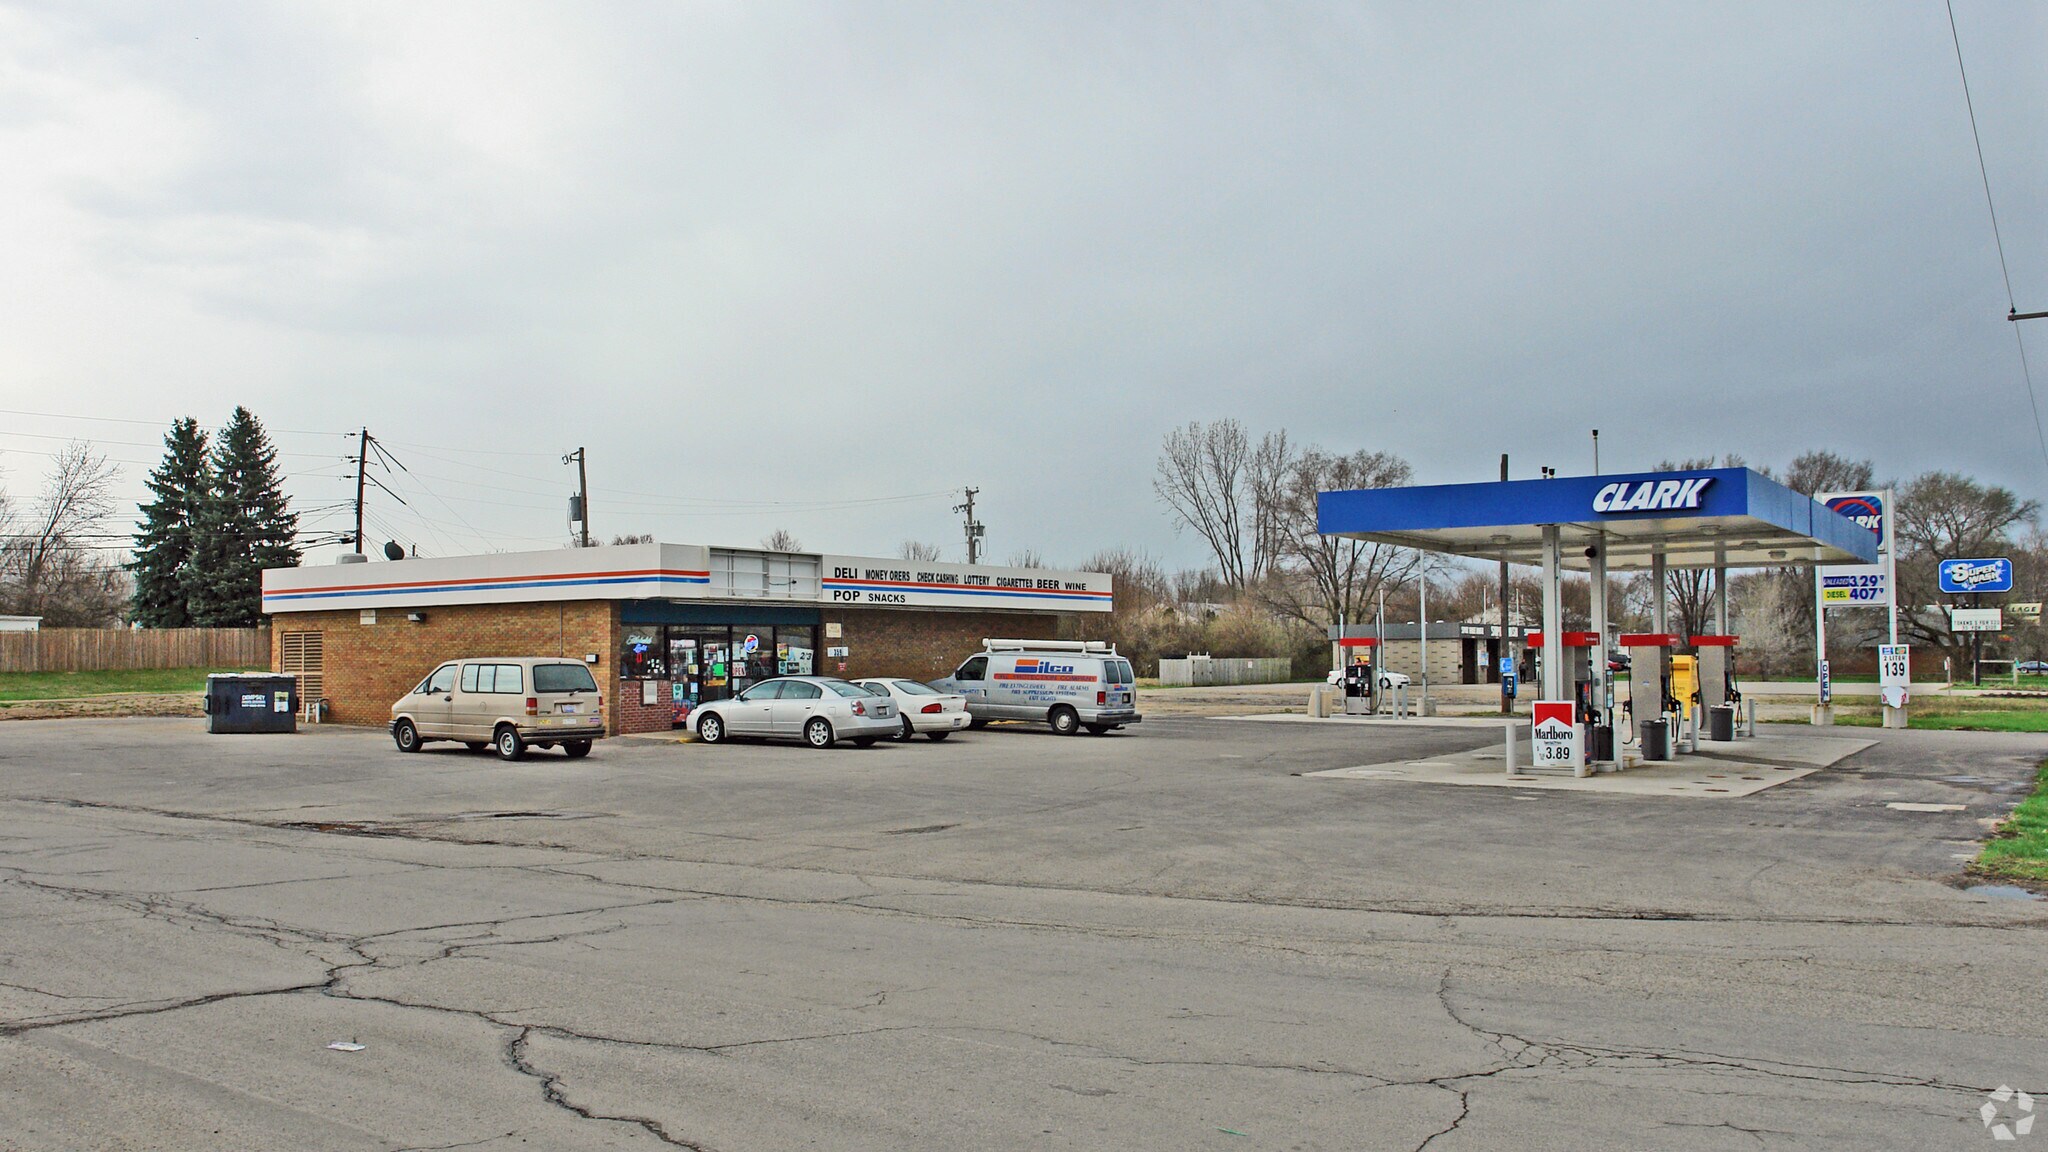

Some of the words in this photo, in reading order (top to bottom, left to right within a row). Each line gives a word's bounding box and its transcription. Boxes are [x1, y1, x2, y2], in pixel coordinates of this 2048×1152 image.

[1592, 478, 1710, 512] CLARK
[834, 567, 858, 579] DELI
[865, 569, 889, 580] MONEY
[889, 571, 911, 581] ORERS
[917, 572, 935, 583] CHECK
[935, 573, 959, 584] CASHING
[964, 574, 990, 586] LOTTERY
[996, 576, 1033, 588] CIGARETTES
[1036, 578, 1060, 590] BEER
[1064, 582, 1087, 591] WINE
[1952, 563, 1996, 584] SUPER
[1969, 573, 1997, 585] WASH
[1824, 577, 1849, 587] UNLEADED
[833, 590, 861, 601] POP
[868, 592, 906, 603] SNACKS
[1826, 591, 1846, 599] DIESEL
[1535, 726, 1573, 739] Marlboro
[1546, 747, 1570, 759] 3.89
